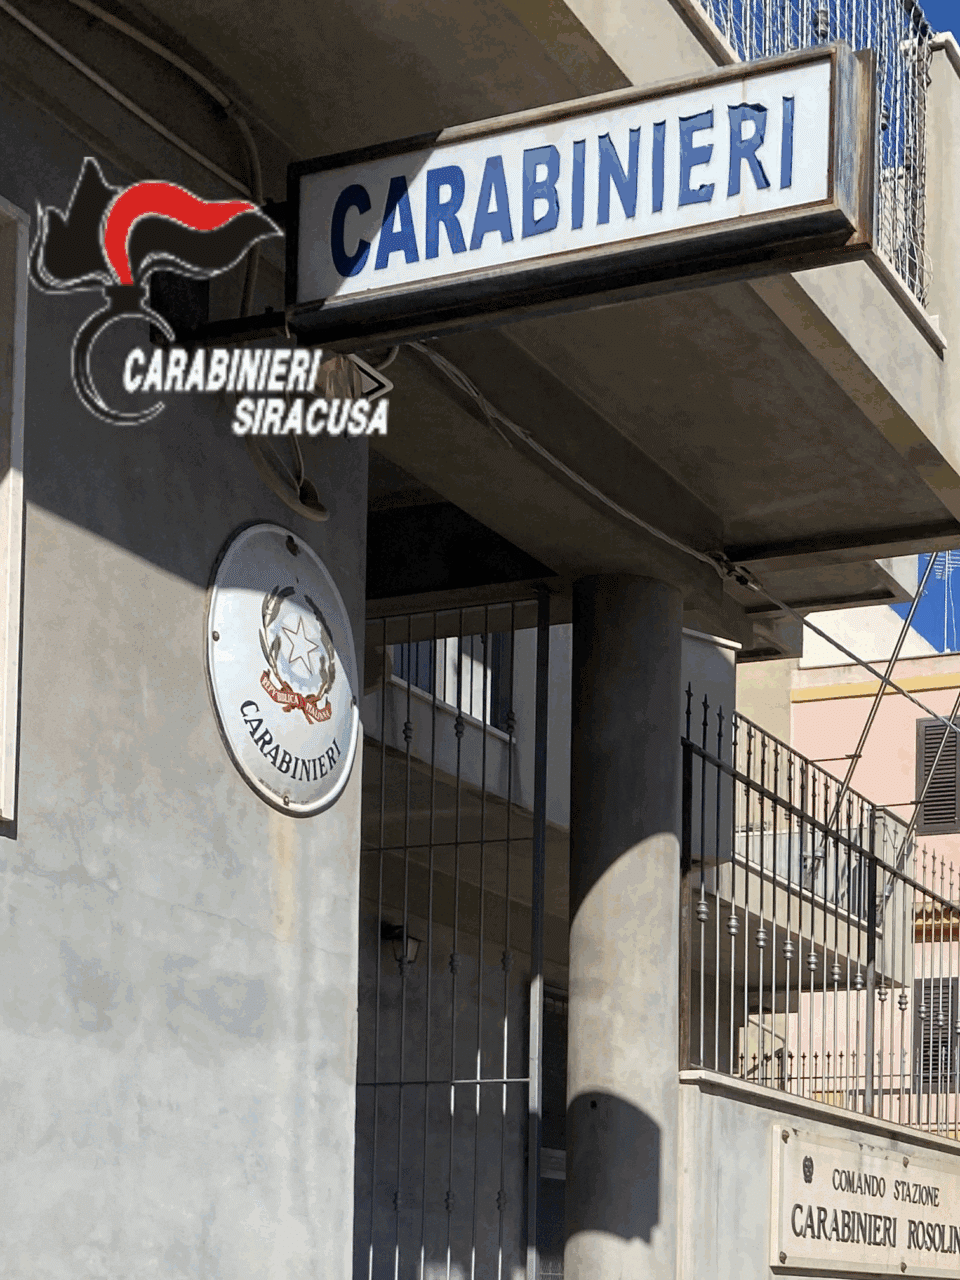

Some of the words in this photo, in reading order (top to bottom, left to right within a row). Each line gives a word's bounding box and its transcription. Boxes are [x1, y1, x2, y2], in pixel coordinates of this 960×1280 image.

[330, 96, 794, 278] CARABINIERI
[240, 700, 341, 781] CARABINIERI
[833, 1168, 886, 1198] COMANDO
[893, 1180, 940, 1207] STAZIONE
[791, 1203, 897, 1248] CARABINIERI
